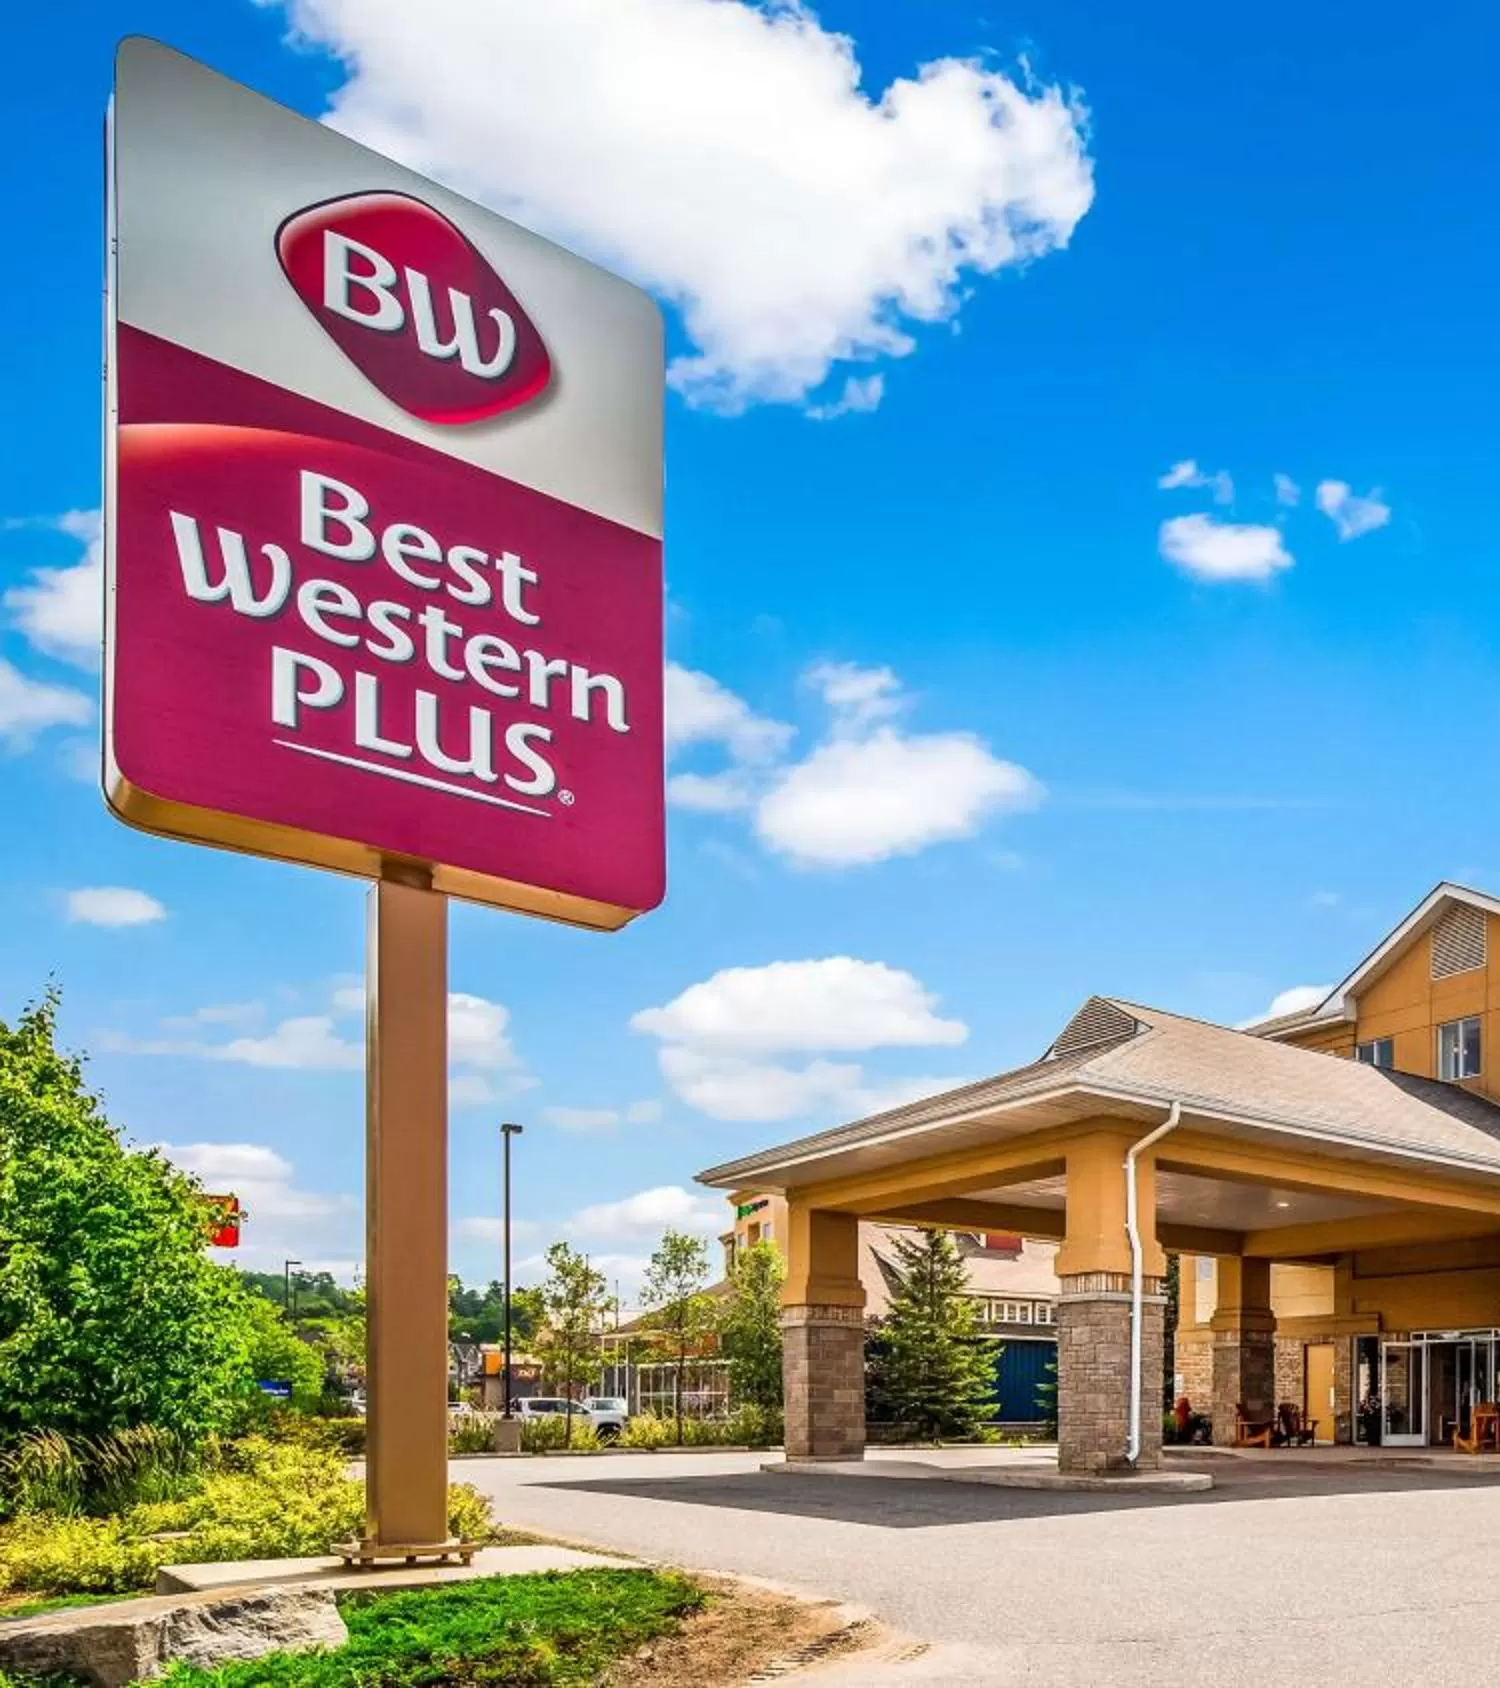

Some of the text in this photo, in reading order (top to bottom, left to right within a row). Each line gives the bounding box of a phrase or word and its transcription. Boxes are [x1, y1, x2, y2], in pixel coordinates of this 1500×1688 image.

[324, 229, 516, 379] BW
[169, 510, 630, 734] Western
[300, 470, 540, 626] Best
